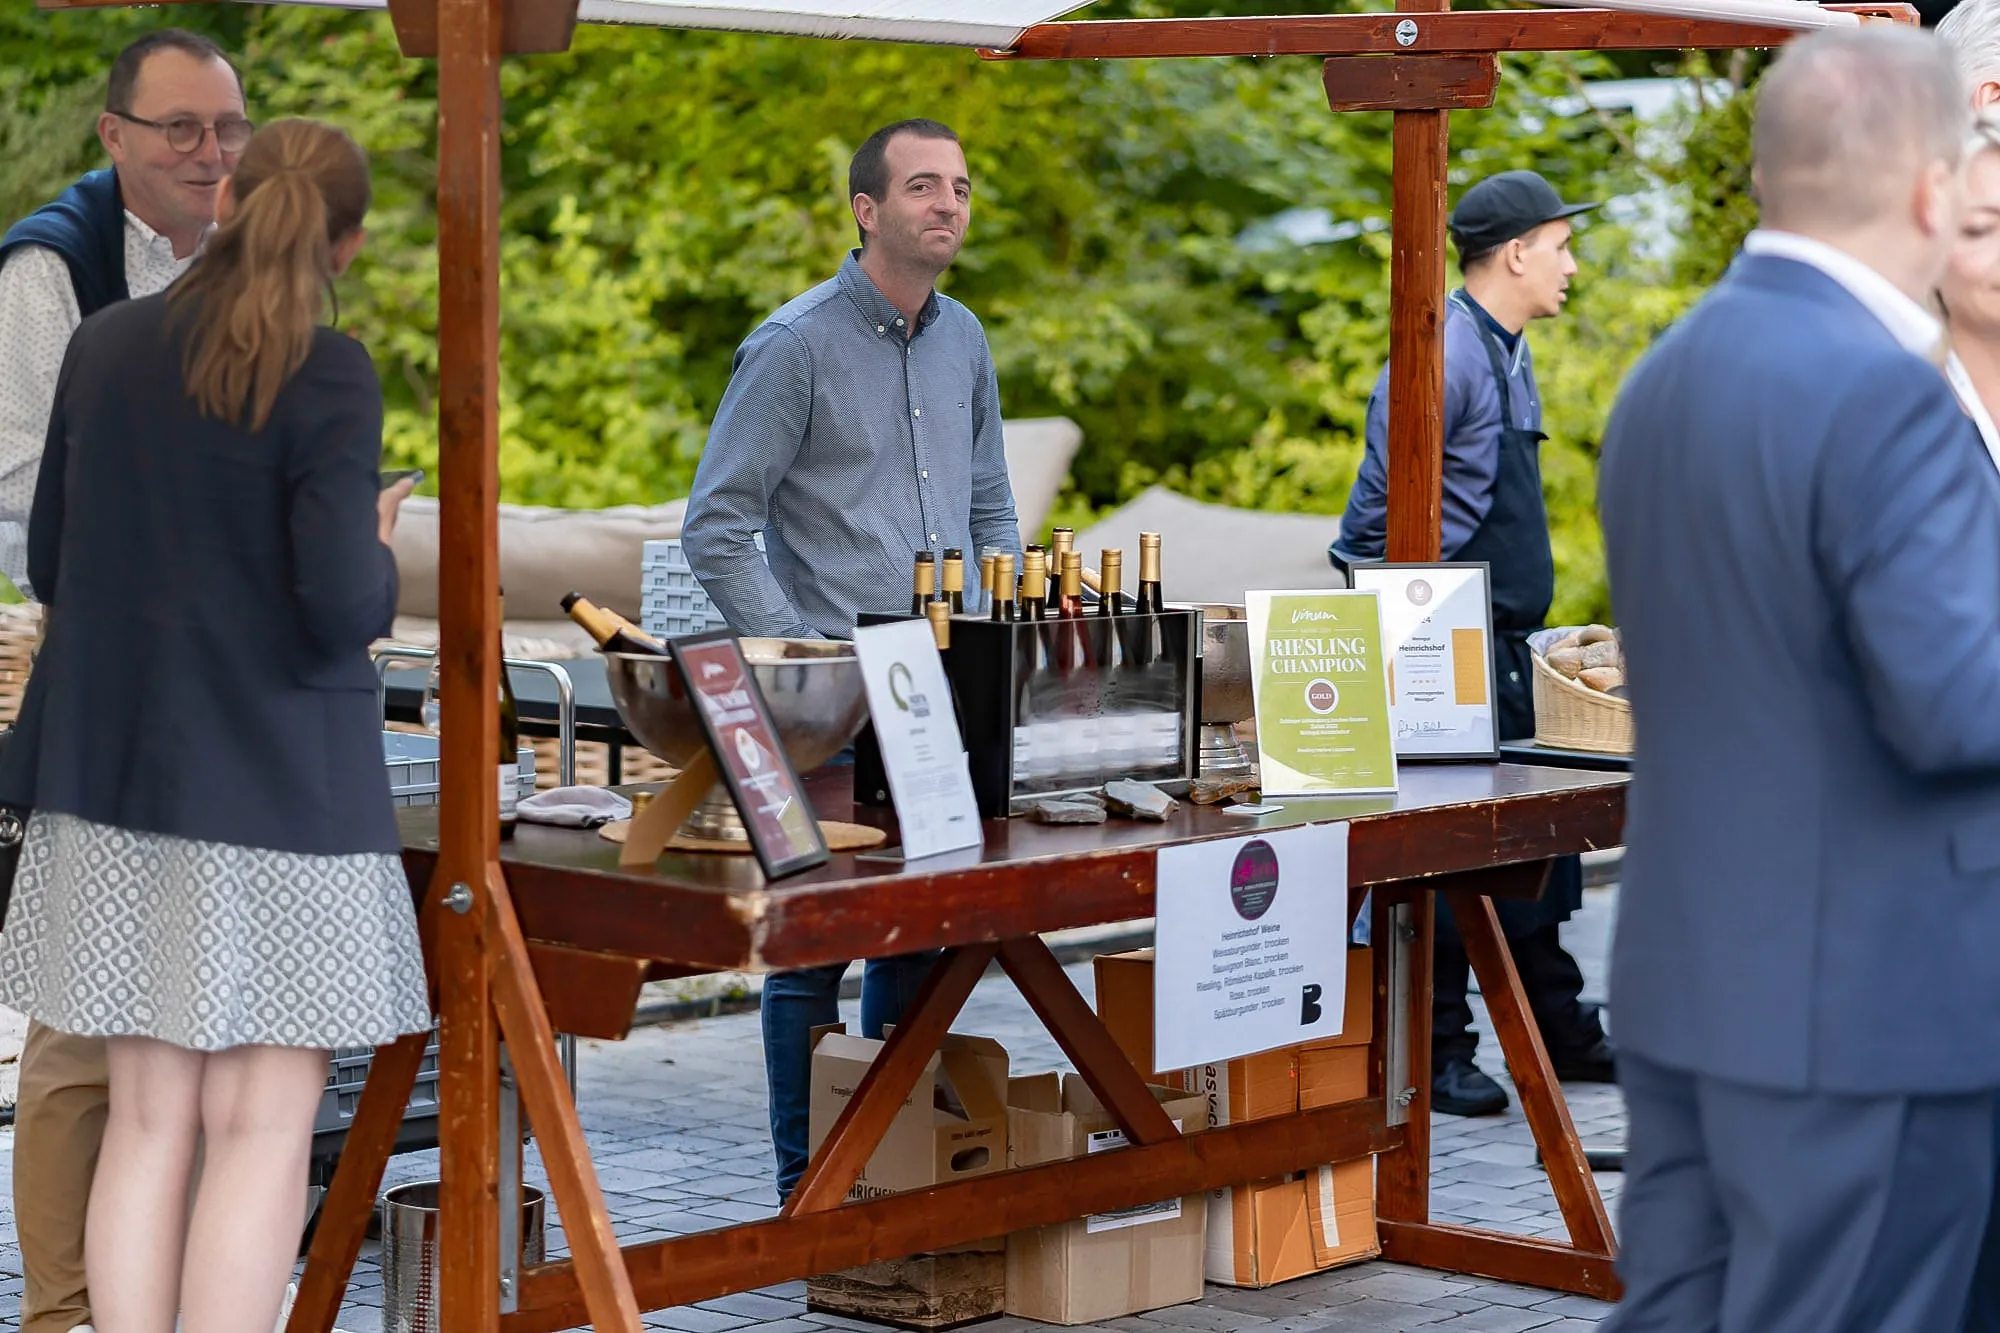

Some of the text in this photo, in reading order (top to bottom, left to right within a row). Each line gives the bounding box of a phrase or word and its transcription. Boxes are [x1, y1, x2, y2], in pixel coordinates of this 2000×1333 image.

[1269, 637, 1366, 657] RIESLING
[1398, 643, 1446, 652] Heinrichshof
[1271, 657, 1367, 674] CHAMPION
[1264, 937, 1289, 949] trocken
[1264, 952, 1289, 963] trocken
[1278, 964, 1304, 976] trocken
[1247, 985, 1271, 997] trocken
[1261, 997, 1286, 1009] trocken
